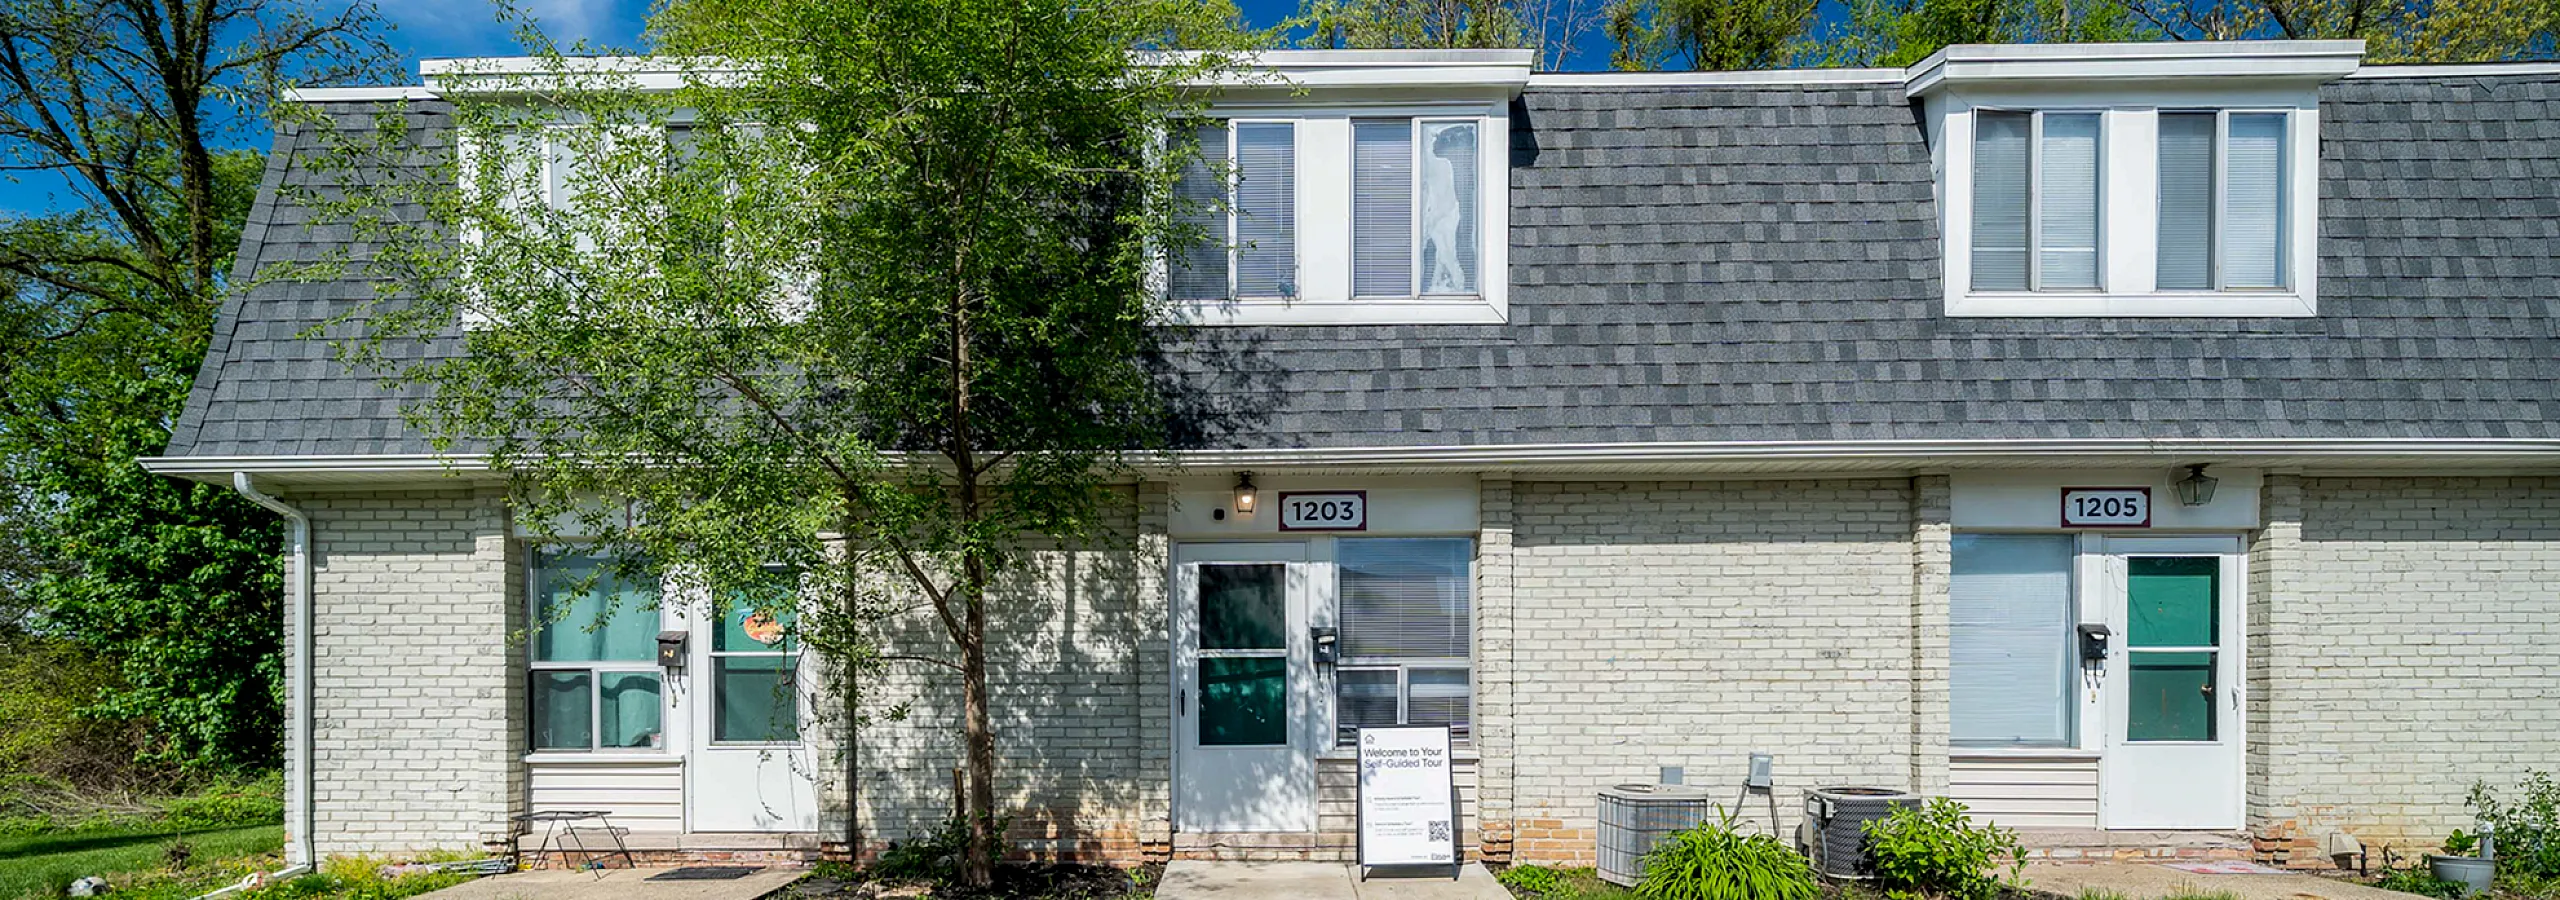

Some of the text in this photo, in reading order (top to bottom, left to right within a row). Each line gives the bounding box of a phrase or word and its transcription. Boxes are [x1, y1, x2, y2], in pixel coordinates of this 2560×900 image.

[1292, 501, 1354, 521] 1203
[2075, 497, 2137, 517] 1205
[1364, 747, 1443, 757] Welcome to Your
[1364, 758, 1443, 768] Self-Guided Tour
